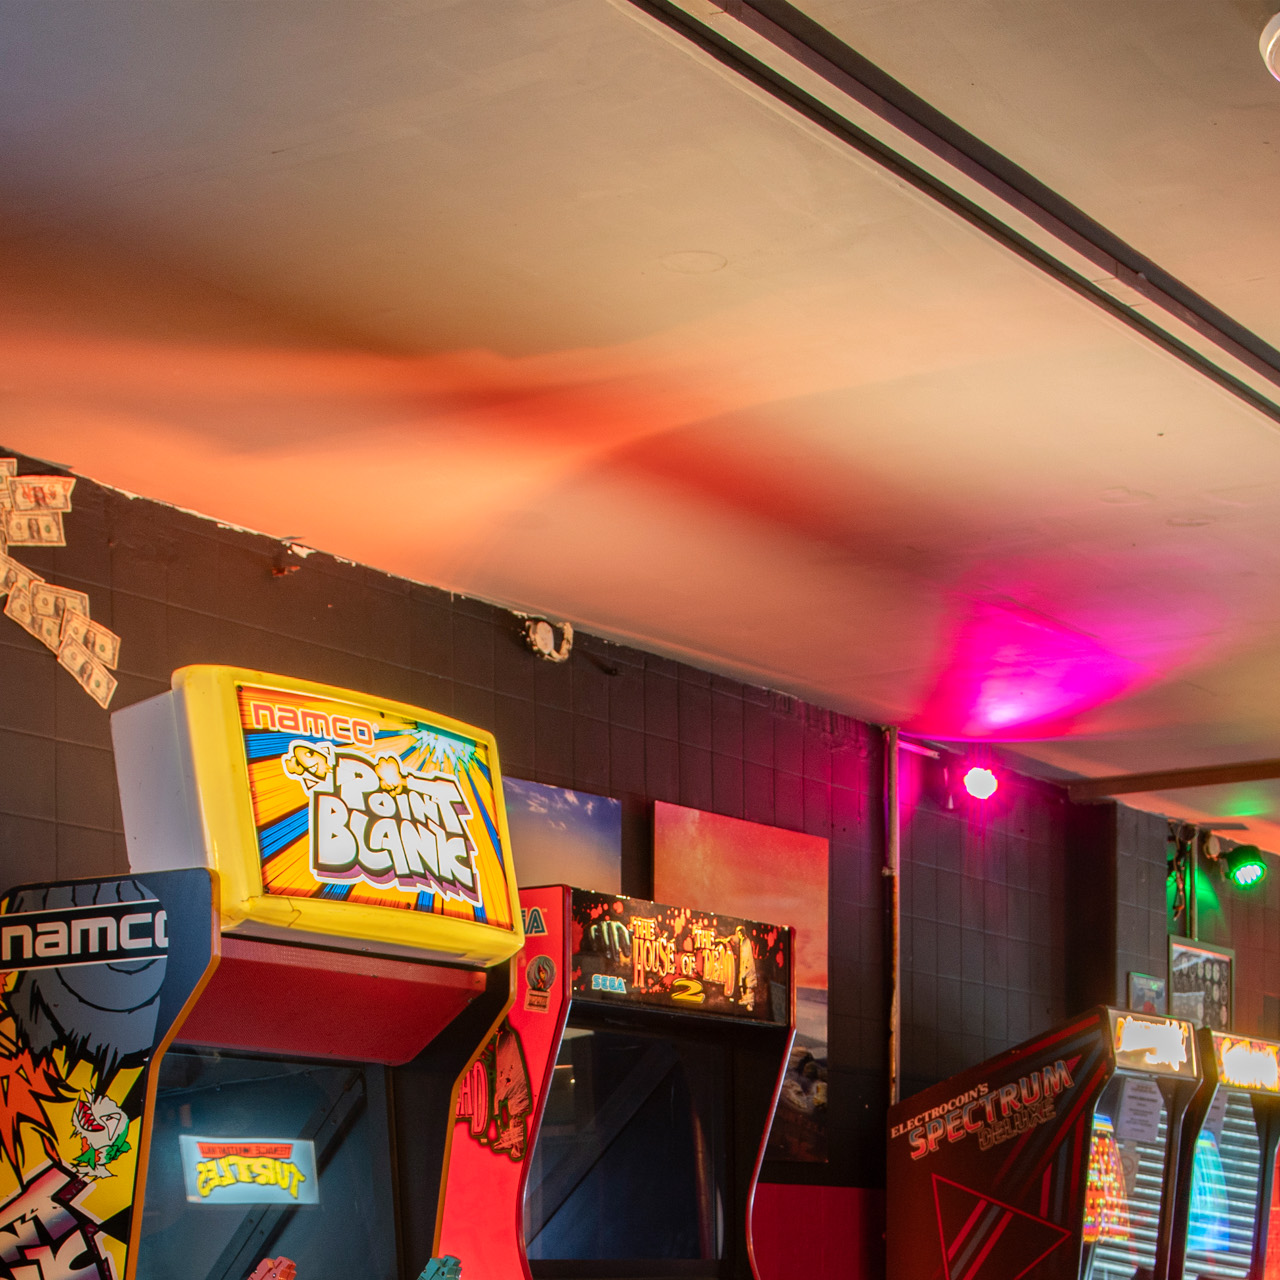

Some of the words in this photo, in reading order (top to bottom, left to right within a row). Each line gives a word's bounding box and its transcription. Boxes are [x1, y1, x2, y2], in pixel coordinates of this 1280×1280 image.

[251, 702, 375, 746] namco
[335, 756, 463, 835] POINT
[317, 794, 475, 889] BLANK
[630, 916, 657, 941] THE
[692, 926, 716, 950] THE
[592, 973, 627, 994] SEGA
[631, 936, 676, 989] HOUSE
[681, 952, 697, 976] OF
[702, 944, 736, 997] DEAD
[671, 977, 706, 1004] 2
[890, 1082, 989, 1139] ELECTROCOIN'S
[908, 1059, 1075, 1161] SPECTRUM
[978, 1097, 1057, 1151] DELUXE
